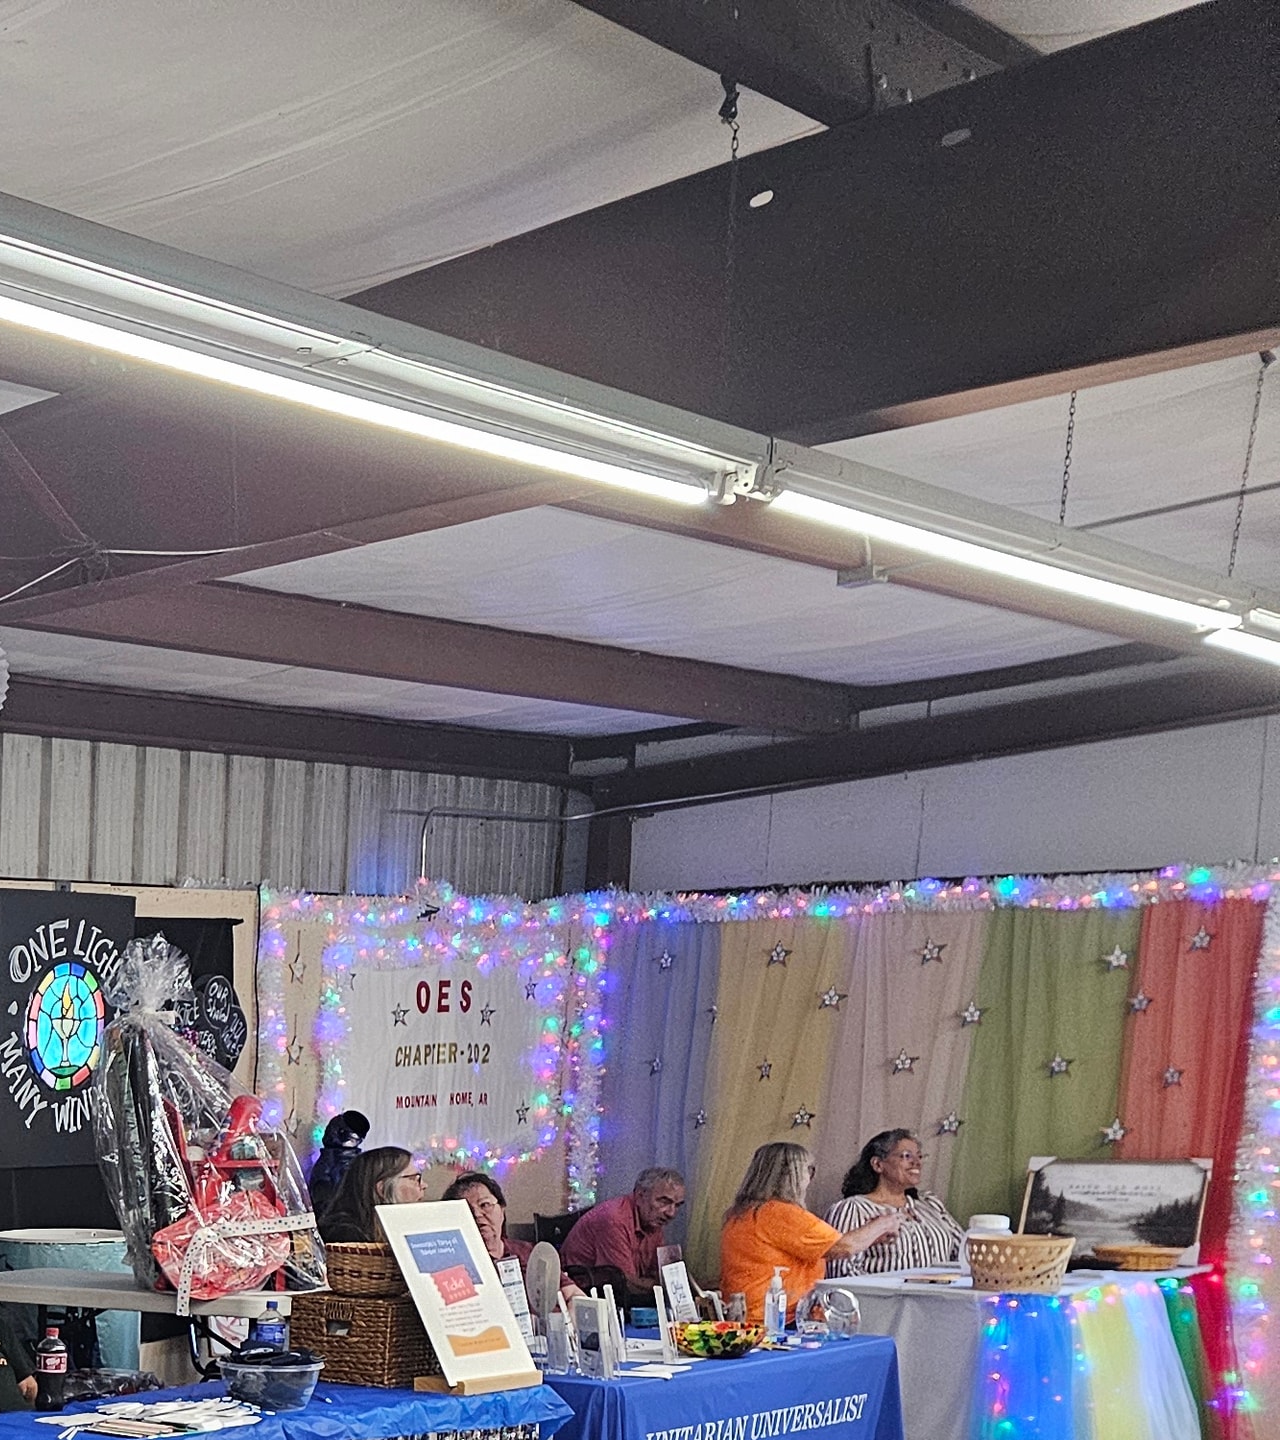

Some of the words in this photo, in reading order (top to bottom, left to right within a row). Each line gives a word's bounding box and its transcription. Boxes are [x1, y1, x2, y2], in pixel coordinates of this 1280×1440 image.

[8, 919, 70, 983] ONE
[73, 919, 121, 981] LIGH
[396, 1095, 438, 1109] MOUNTAIN
[479, 1093, 488, 1105] AR
